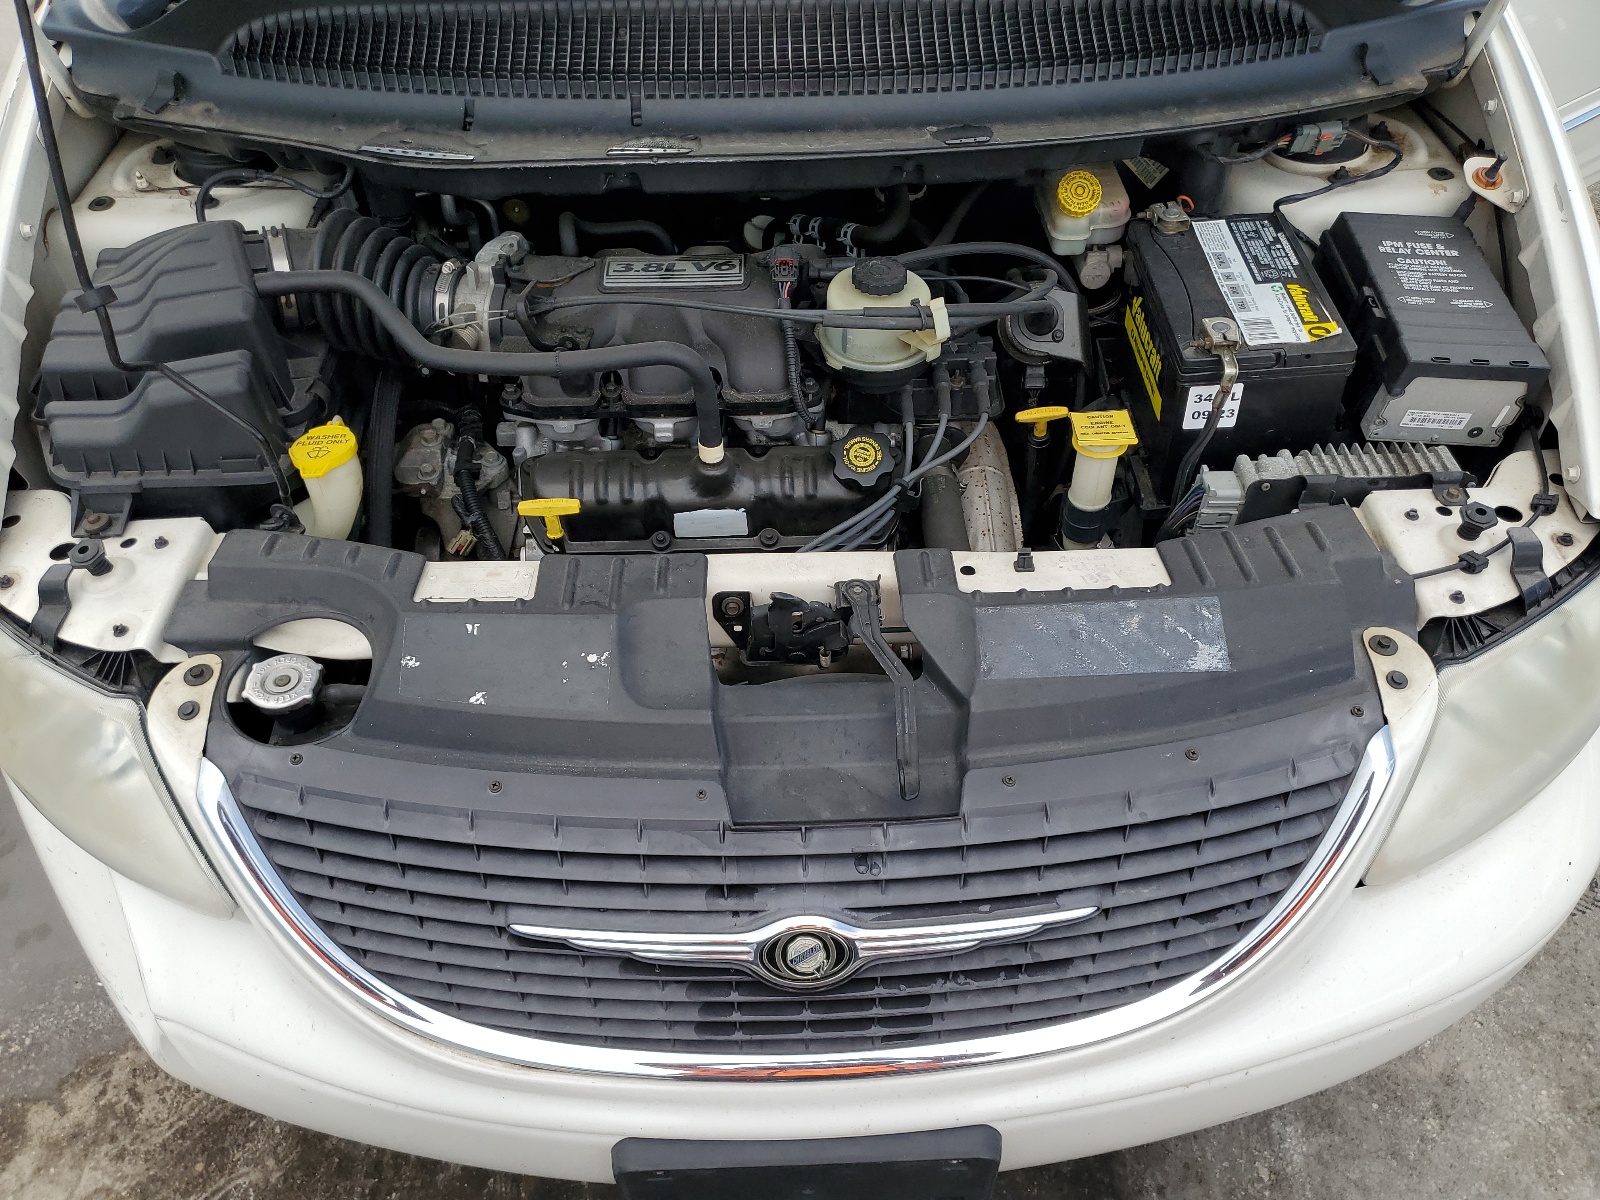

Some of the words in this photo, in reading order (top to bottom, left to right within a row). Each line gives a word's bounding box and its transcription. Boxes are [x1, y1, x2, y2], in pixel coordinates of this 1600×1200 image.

[1381, 240, 1404, 248] IPM
[1406, 242, 1434, 250] FUSE
[1378, 246, 1411, 254] RELAY
[1415, 248, 1460, 257] CENTER
[612, 262, 687, 273] 3.8L
[690, 261, 738, 272] V6
[1396, 257, 1448, 266] CAUTION!
[1193, 392, 1240, 403] 34L
[1191, 409, 1235, 420] 0923
[792, 943, 822, 965] CHRYSLER
